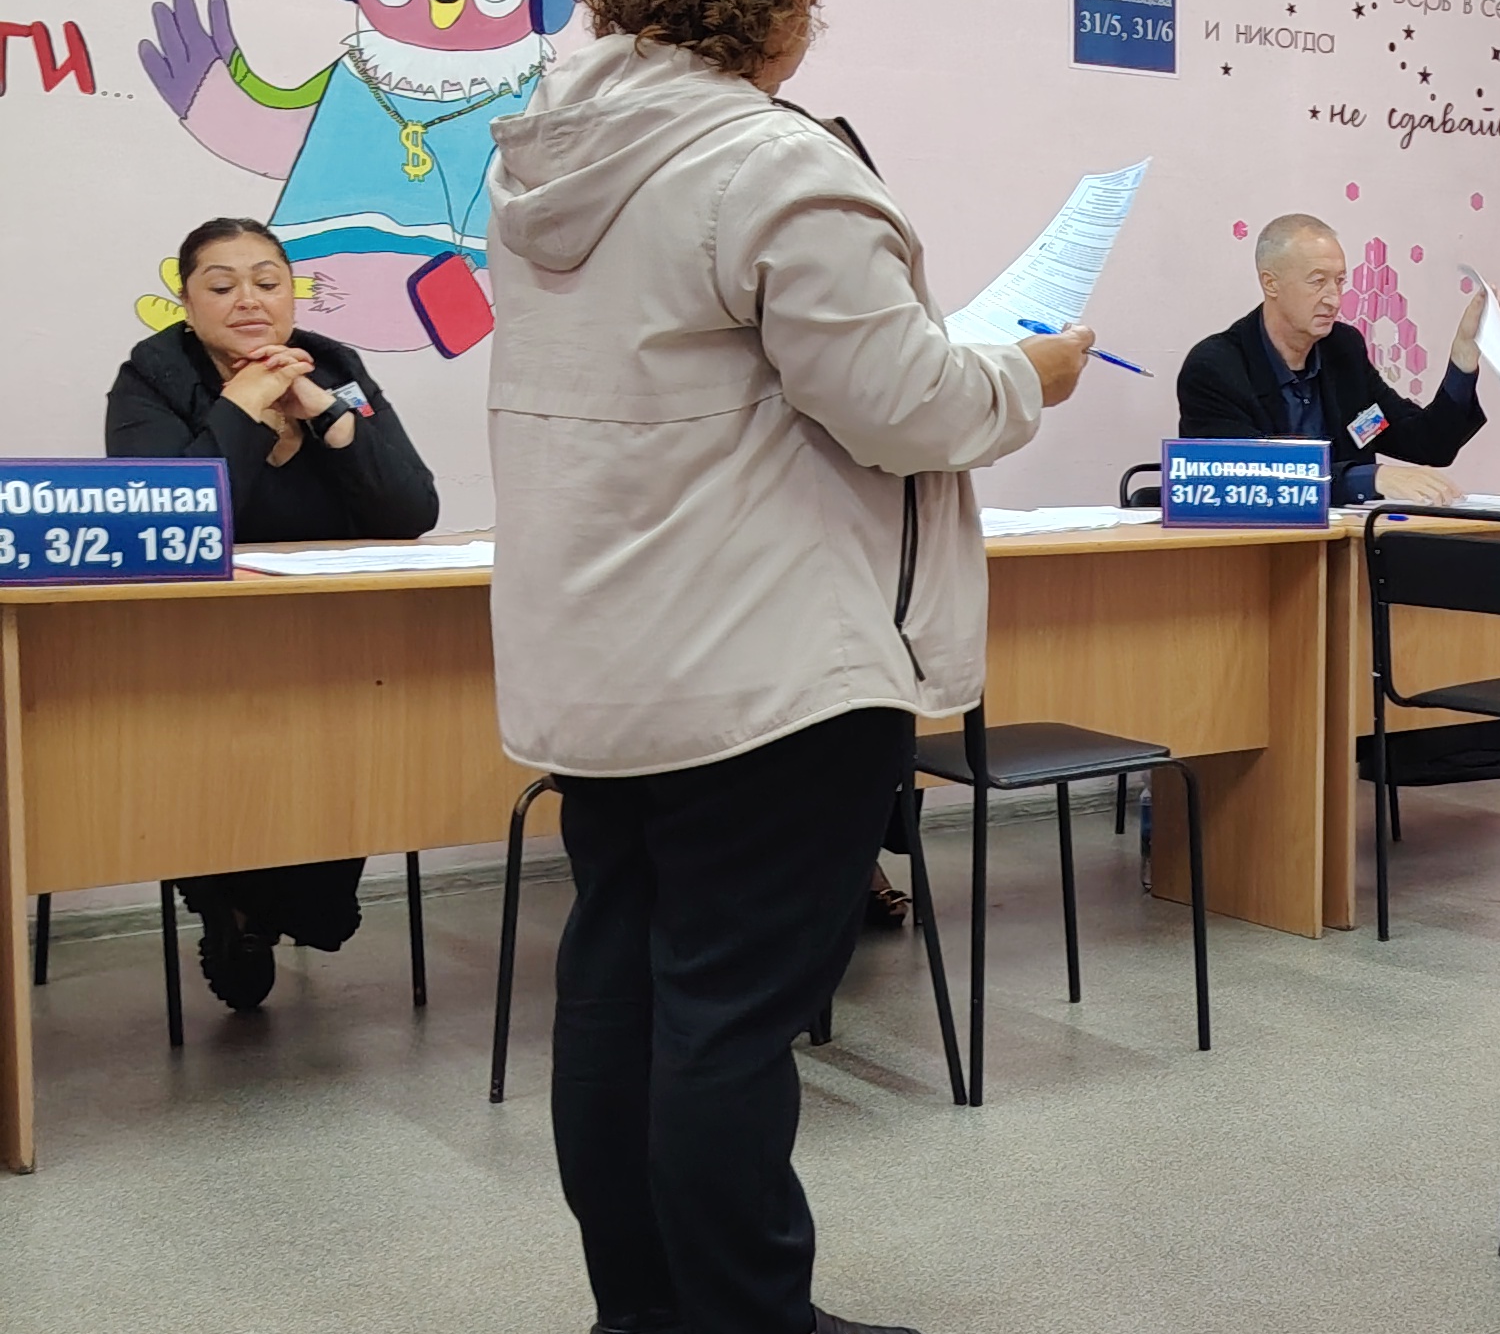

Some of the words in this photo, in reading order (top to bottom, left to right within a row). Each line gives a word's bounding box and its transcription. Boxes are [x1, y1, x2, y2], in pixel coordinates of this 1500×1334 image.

[1079, 10, 1128, 42] 31/5,
[1132, 17, 1174, 43] 31/6
[1235, 23, 1335, 54] никогда
[1329, 103, 1367, 128] не
[1169, 457, 1320, 480] Дикопольцева
[0, 480, 218, 514] Юбилейная
[1171, 484, 1221, 507] 31/2,
[1225, 484, 1273, 507] 31/3,
[1277, 485, 1318, 507] 31/4
[45, 527, 123, 568] 3/2,
[138, 525, 223, 564] 13/3
